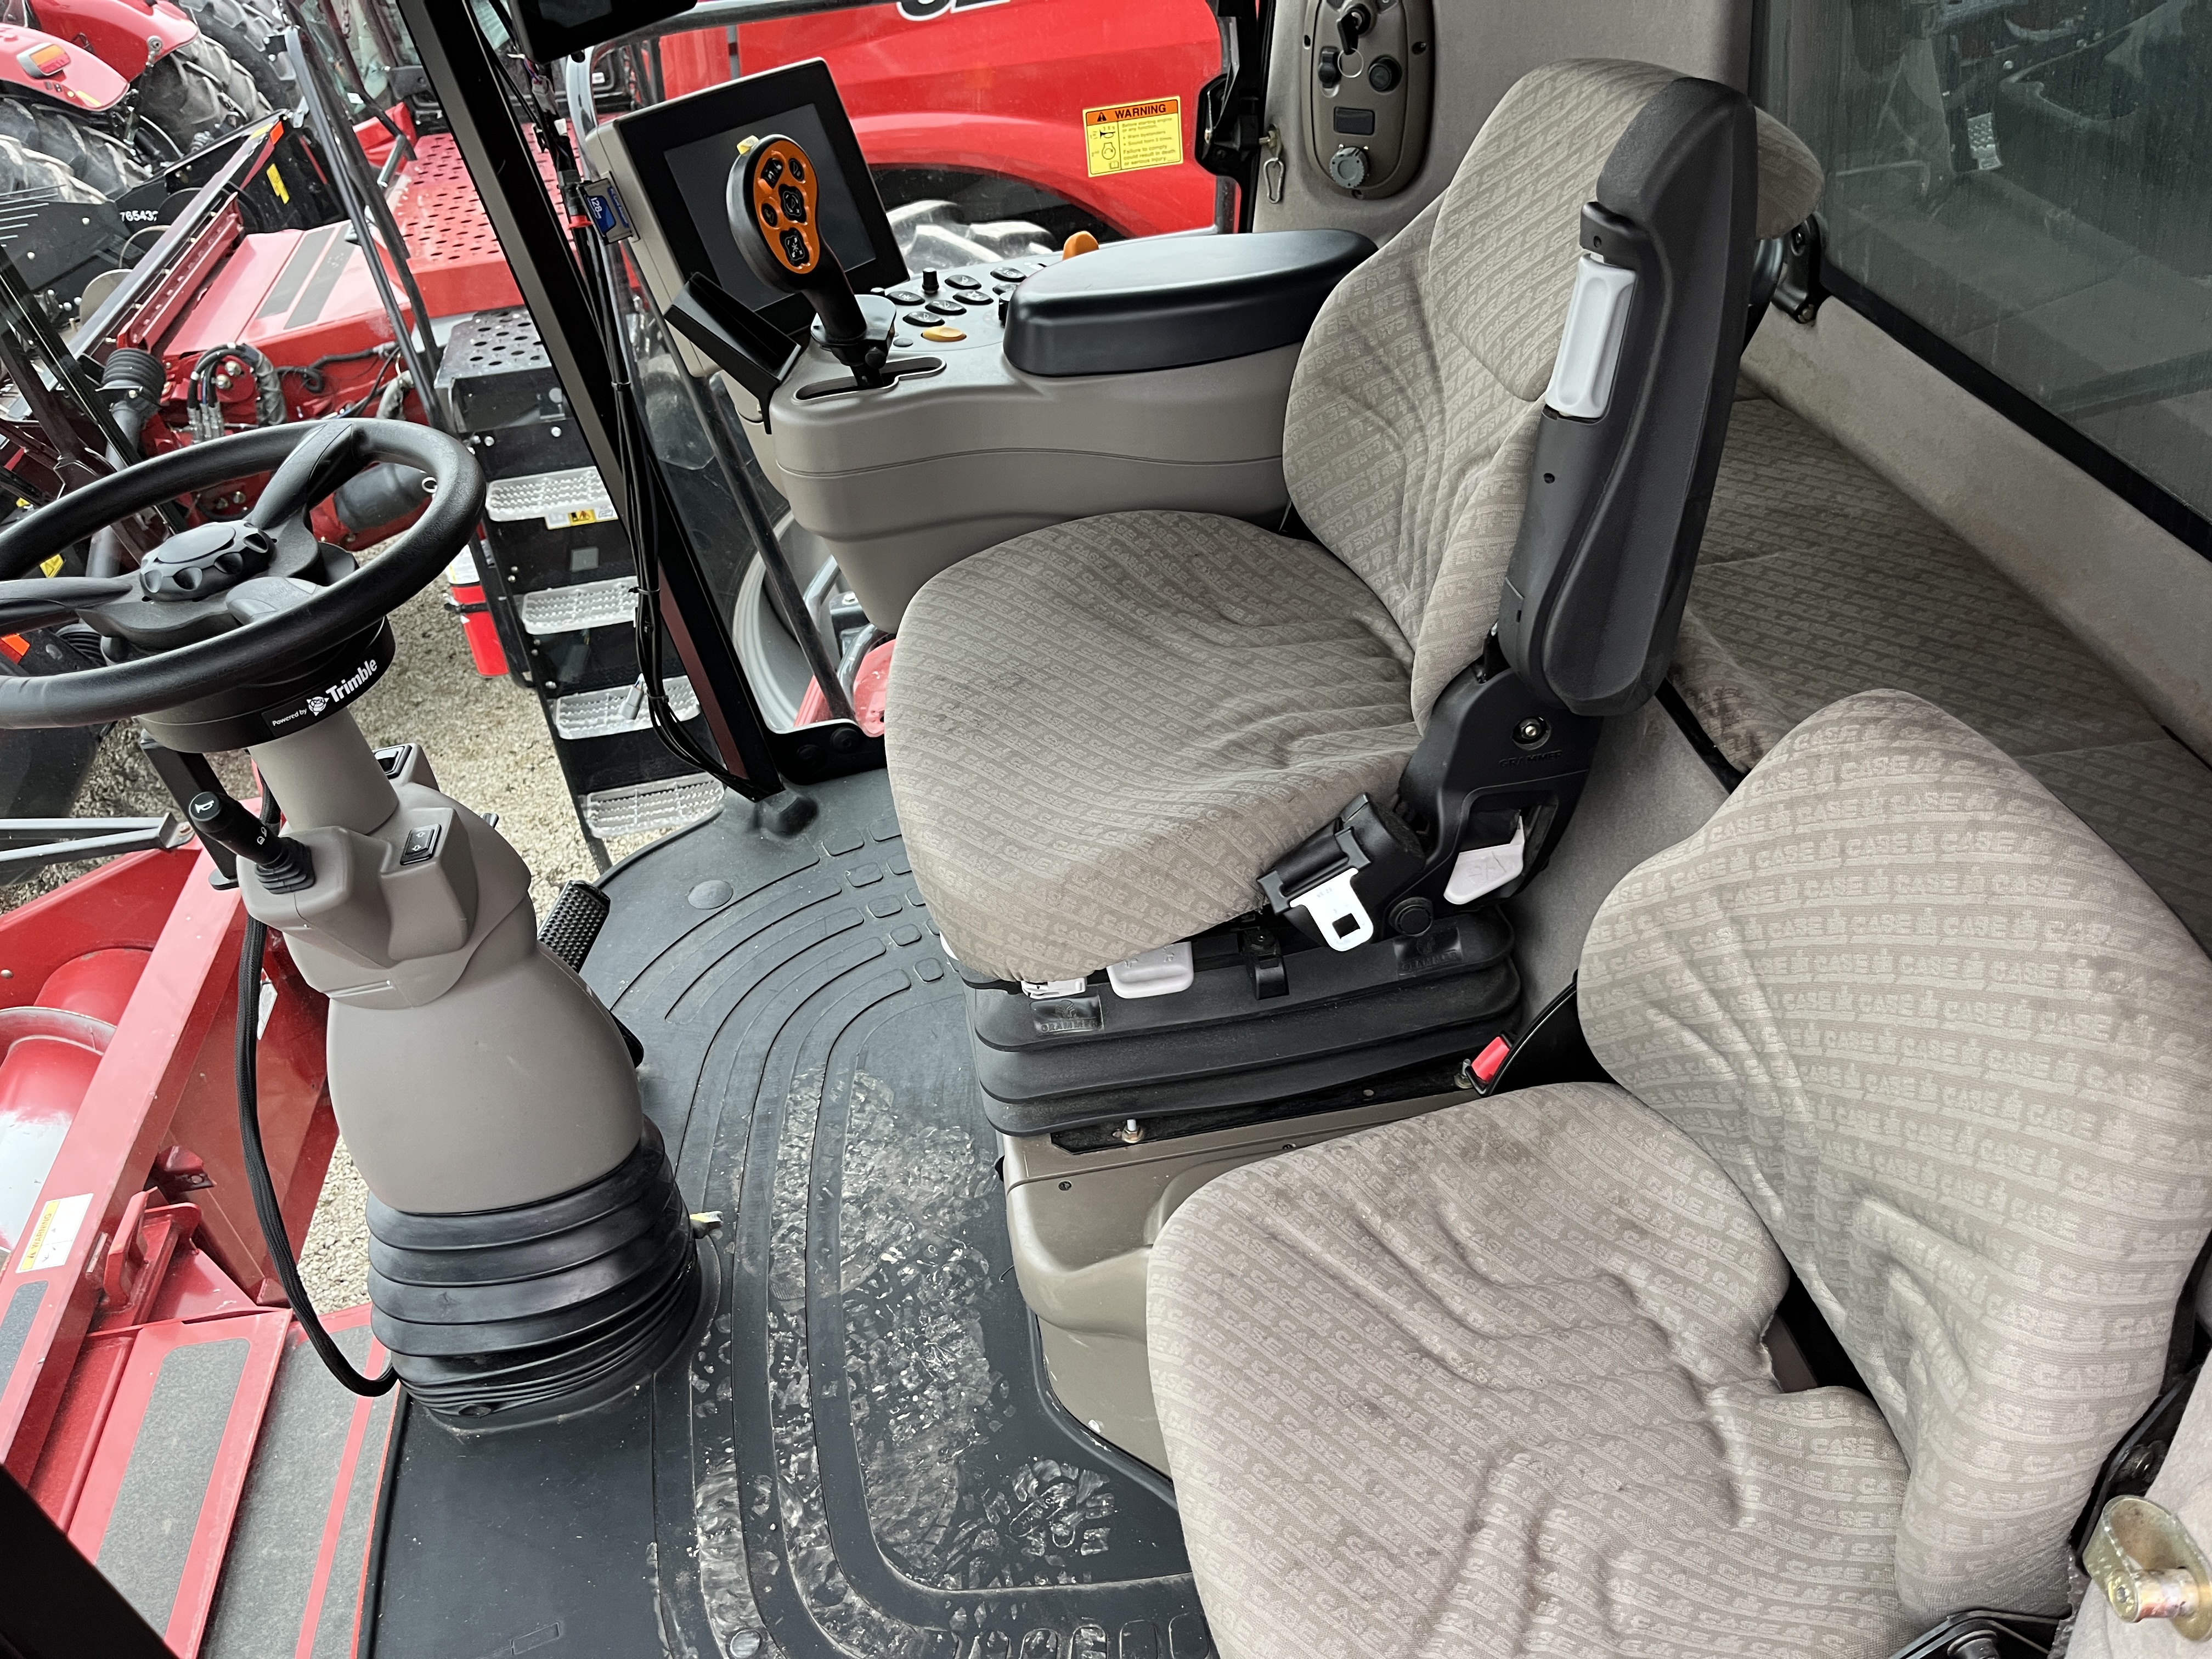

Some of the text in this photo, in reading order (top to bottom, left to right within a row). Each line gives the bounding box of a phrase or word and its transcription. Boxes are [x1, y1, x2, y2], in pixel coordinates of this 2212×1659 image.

[1115, 104, 1166, 119] WARNING
[590, 197, 602, 213] 128
[272, 710, 299, 726] Powered
[325, 659, 377, 703] Trimble
[30, 1212, 52, 1250] WARNING
